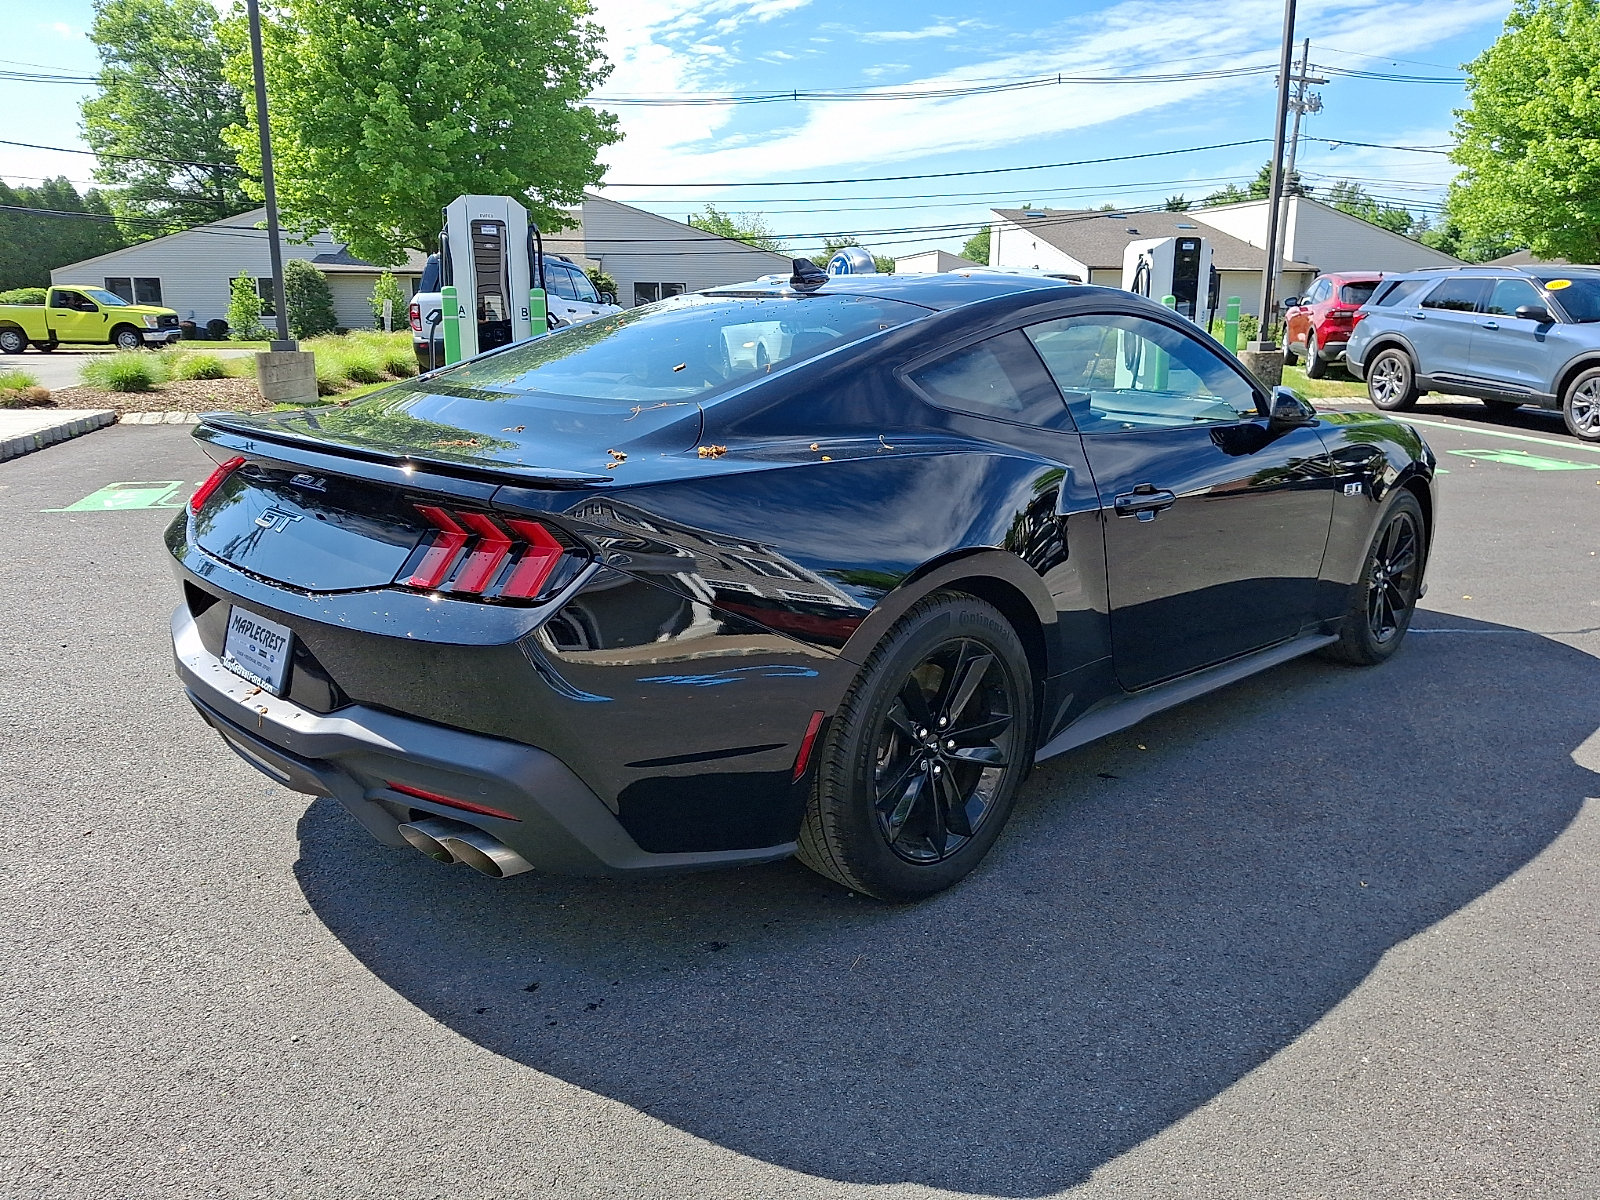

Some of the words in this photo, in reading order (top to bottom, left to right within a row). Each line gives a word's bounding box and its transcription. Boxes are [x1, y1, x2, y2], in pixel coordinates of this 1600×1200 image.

[458, 305, 466, 315] A
[521, 307, 529, 317] B
[254, 507, 304, 533] GT
[231, 614, 287, 653] MAPLECREST
[959, 610, 1011, 640] Continental
